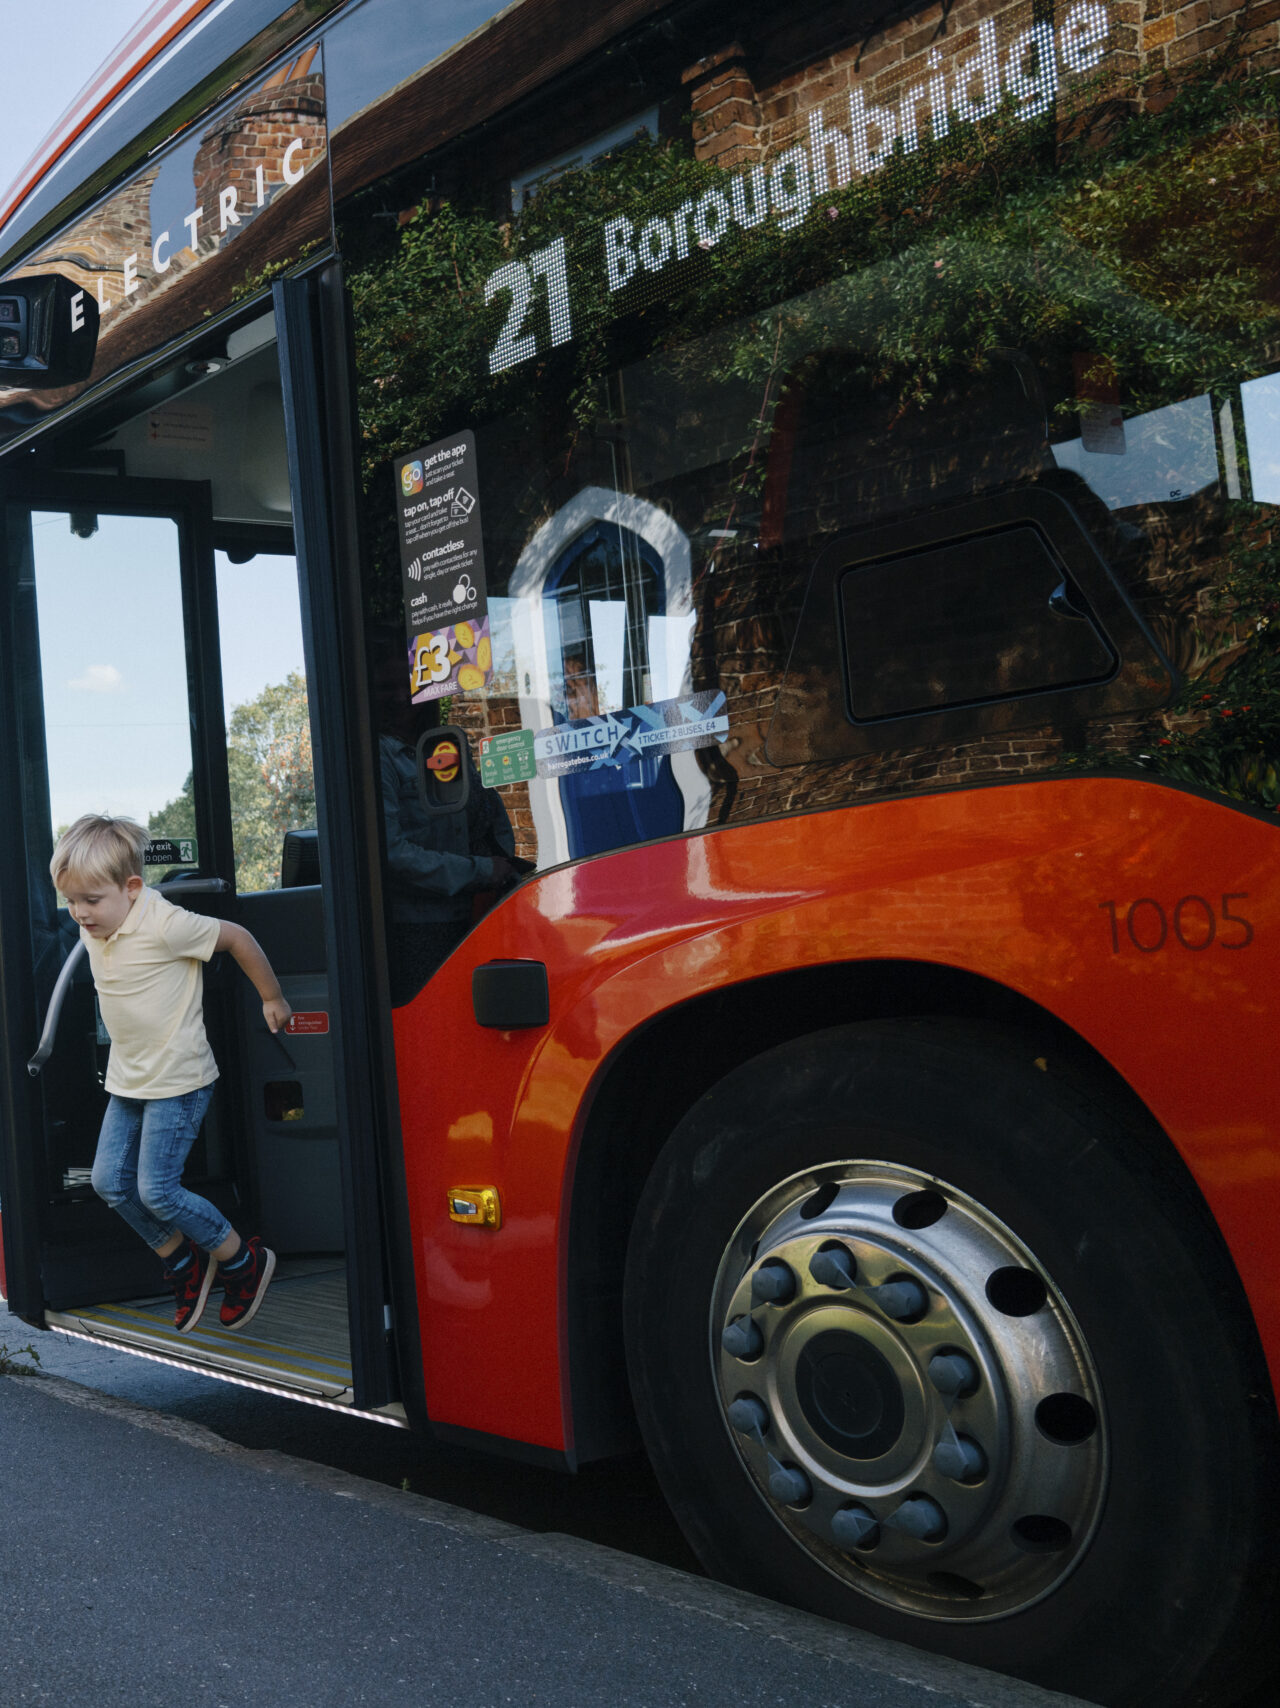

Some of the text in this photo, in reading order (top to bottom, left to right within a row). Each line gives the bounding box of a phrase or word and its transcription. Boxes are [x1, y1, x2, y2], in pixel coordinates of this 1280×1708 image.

[484, 1, 1110, 375] 21 Boroughbridge
[71, 138, 305, 332] ELECTRIC
[424, 444, 466, 470] get the app
[404, 468, 420, 491] go
[404, 487, 454, 517] tap on, tap off
[422, 540, 464, 561] contactless
[411, 592, 427, 607] cash
[415, 635, 451, 687] £3
[424, 681, 458, 697] MAX FARE
[706, 721, 716, 731] £4
[546, 725, 618, 755] SWITCH
[548, 752, 609, 770] harrogatebus.co.uk
[156, 842, 172, 851] exit
[153, 855, 172, 863] open
[1098, 892, 1254, 954] 1005
